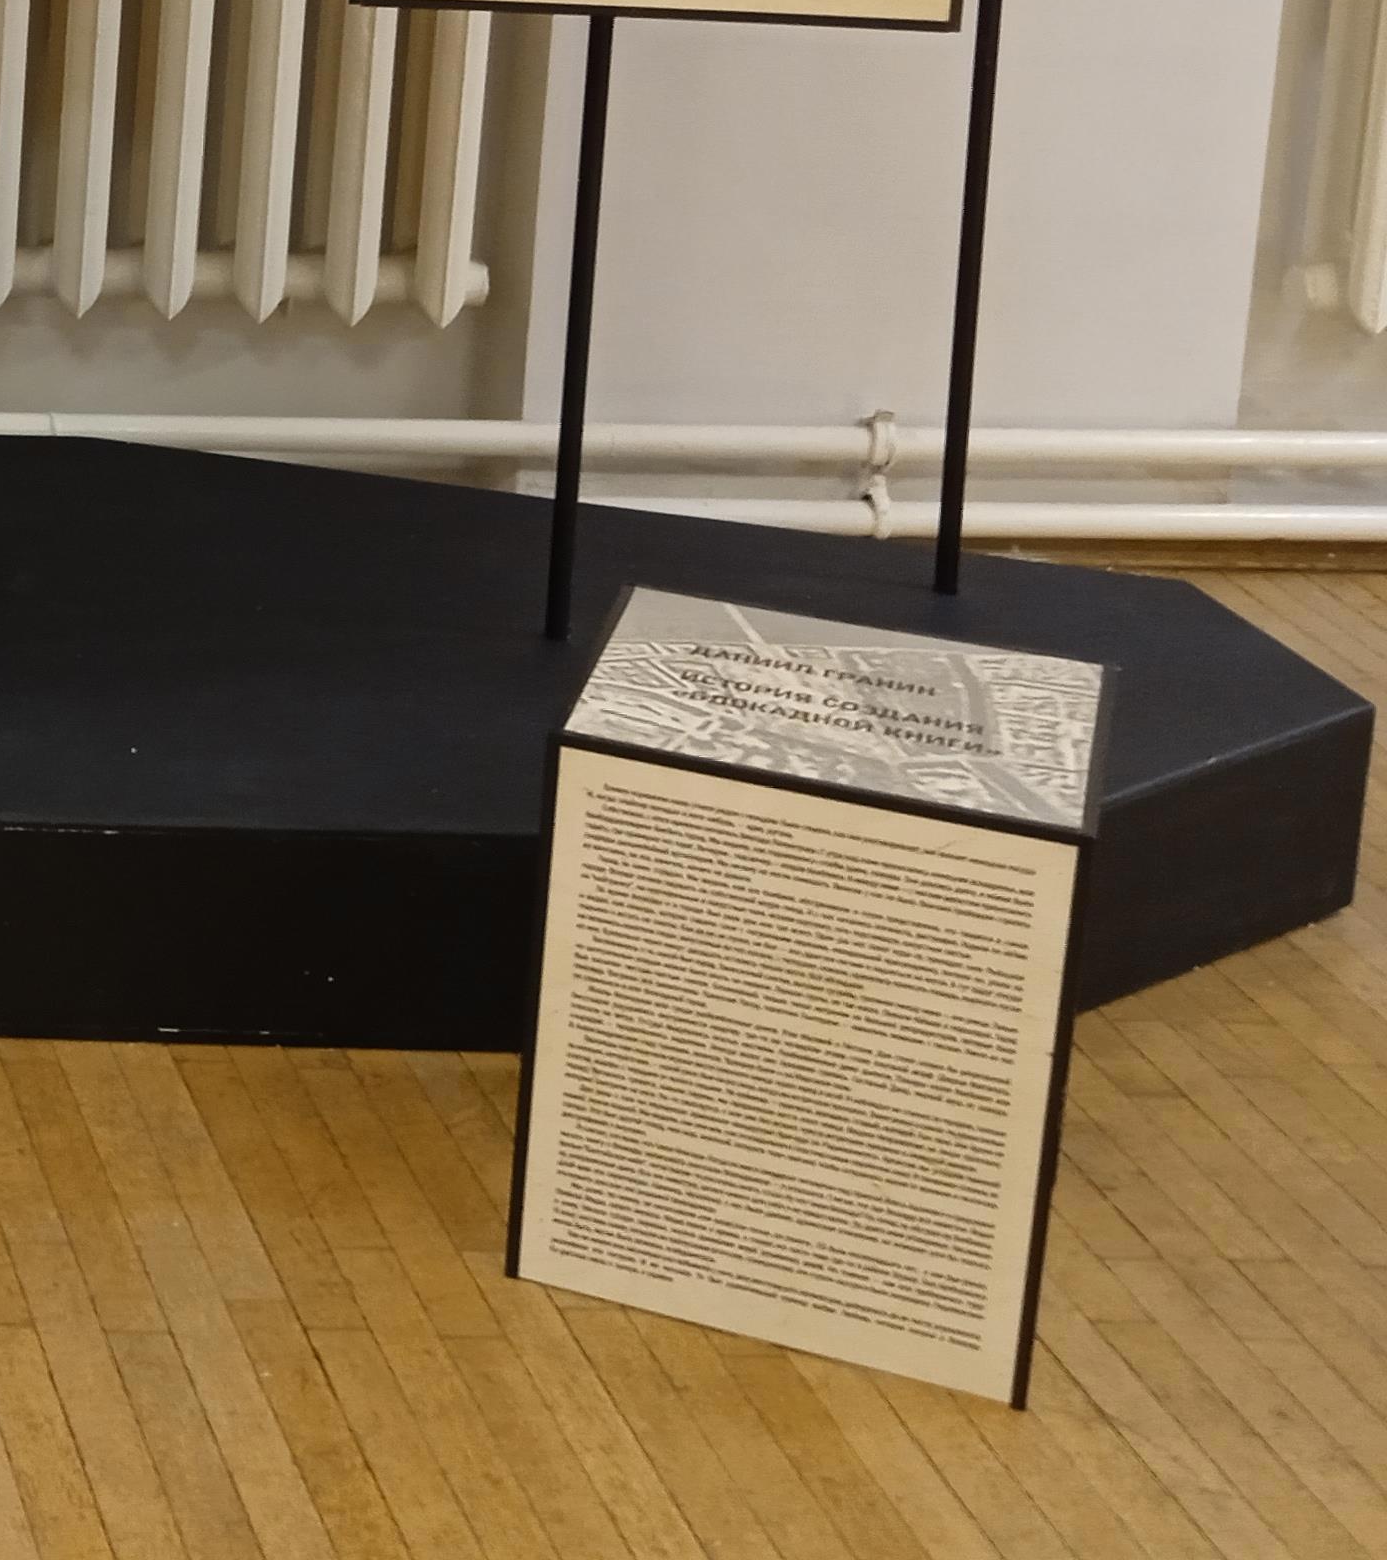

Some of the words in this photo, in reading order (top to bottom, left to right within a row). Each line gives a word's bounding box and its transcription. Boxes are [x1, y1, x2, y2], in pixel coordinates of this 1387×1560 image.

[690, 644, 815, 675] ДАНИИЛ
[822, 668, 936, 697] ГРАНИН
[680, 669, 813, 703] ИСТОРИЯ
[822, 695, 984, 736] СОЗДАНИЯ
